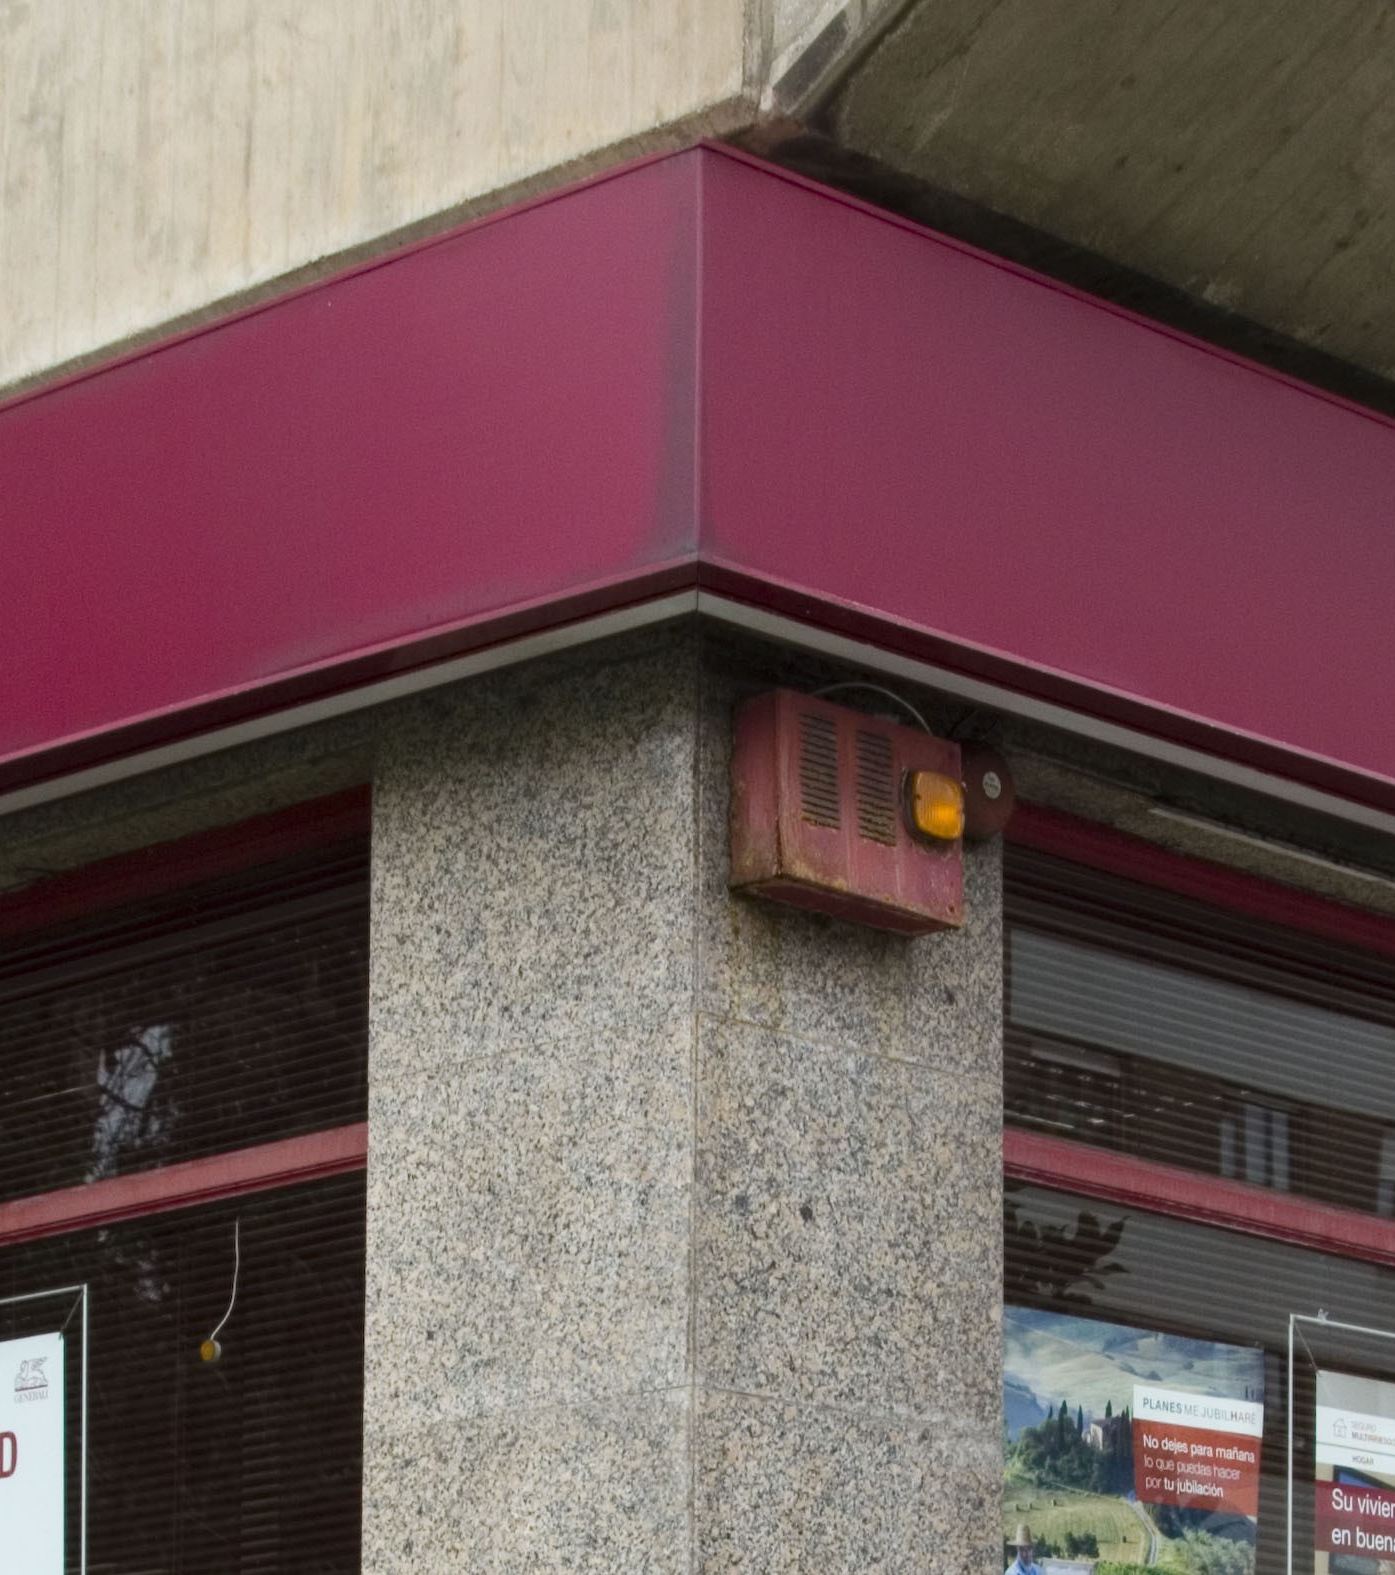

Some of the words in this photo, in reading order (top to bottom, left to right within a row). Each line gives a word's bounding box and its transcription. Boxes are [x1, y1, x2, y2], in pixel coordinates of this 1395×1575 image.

[1143, 1397, 1182, 1414] PLANES
[1184, 1404, 1198, 1416] ME
[1143, 1434, 1158, 1449] No
[1161, 1437, 1188, 1455] dejes
[1190, 1443, 1213, 1458] para
[1216, 1446, 1255, 1463] mañana
[1144, 1454, 1153, 1468] lo
[1156, 1457, 1174, 1471] que
[1177, 1461, 1211, 1477] puedas
[1213, 1464, 1241, 1480] hacer
[1145, 1477, 1161, 1490] por
[1164, 1477, 1174, 1491] tu
[1177, 1478, 1223, 1498] jubilación
[1331, 1488, 1353, 1512] Su
[1331, 1527, 1351, 1546] en
